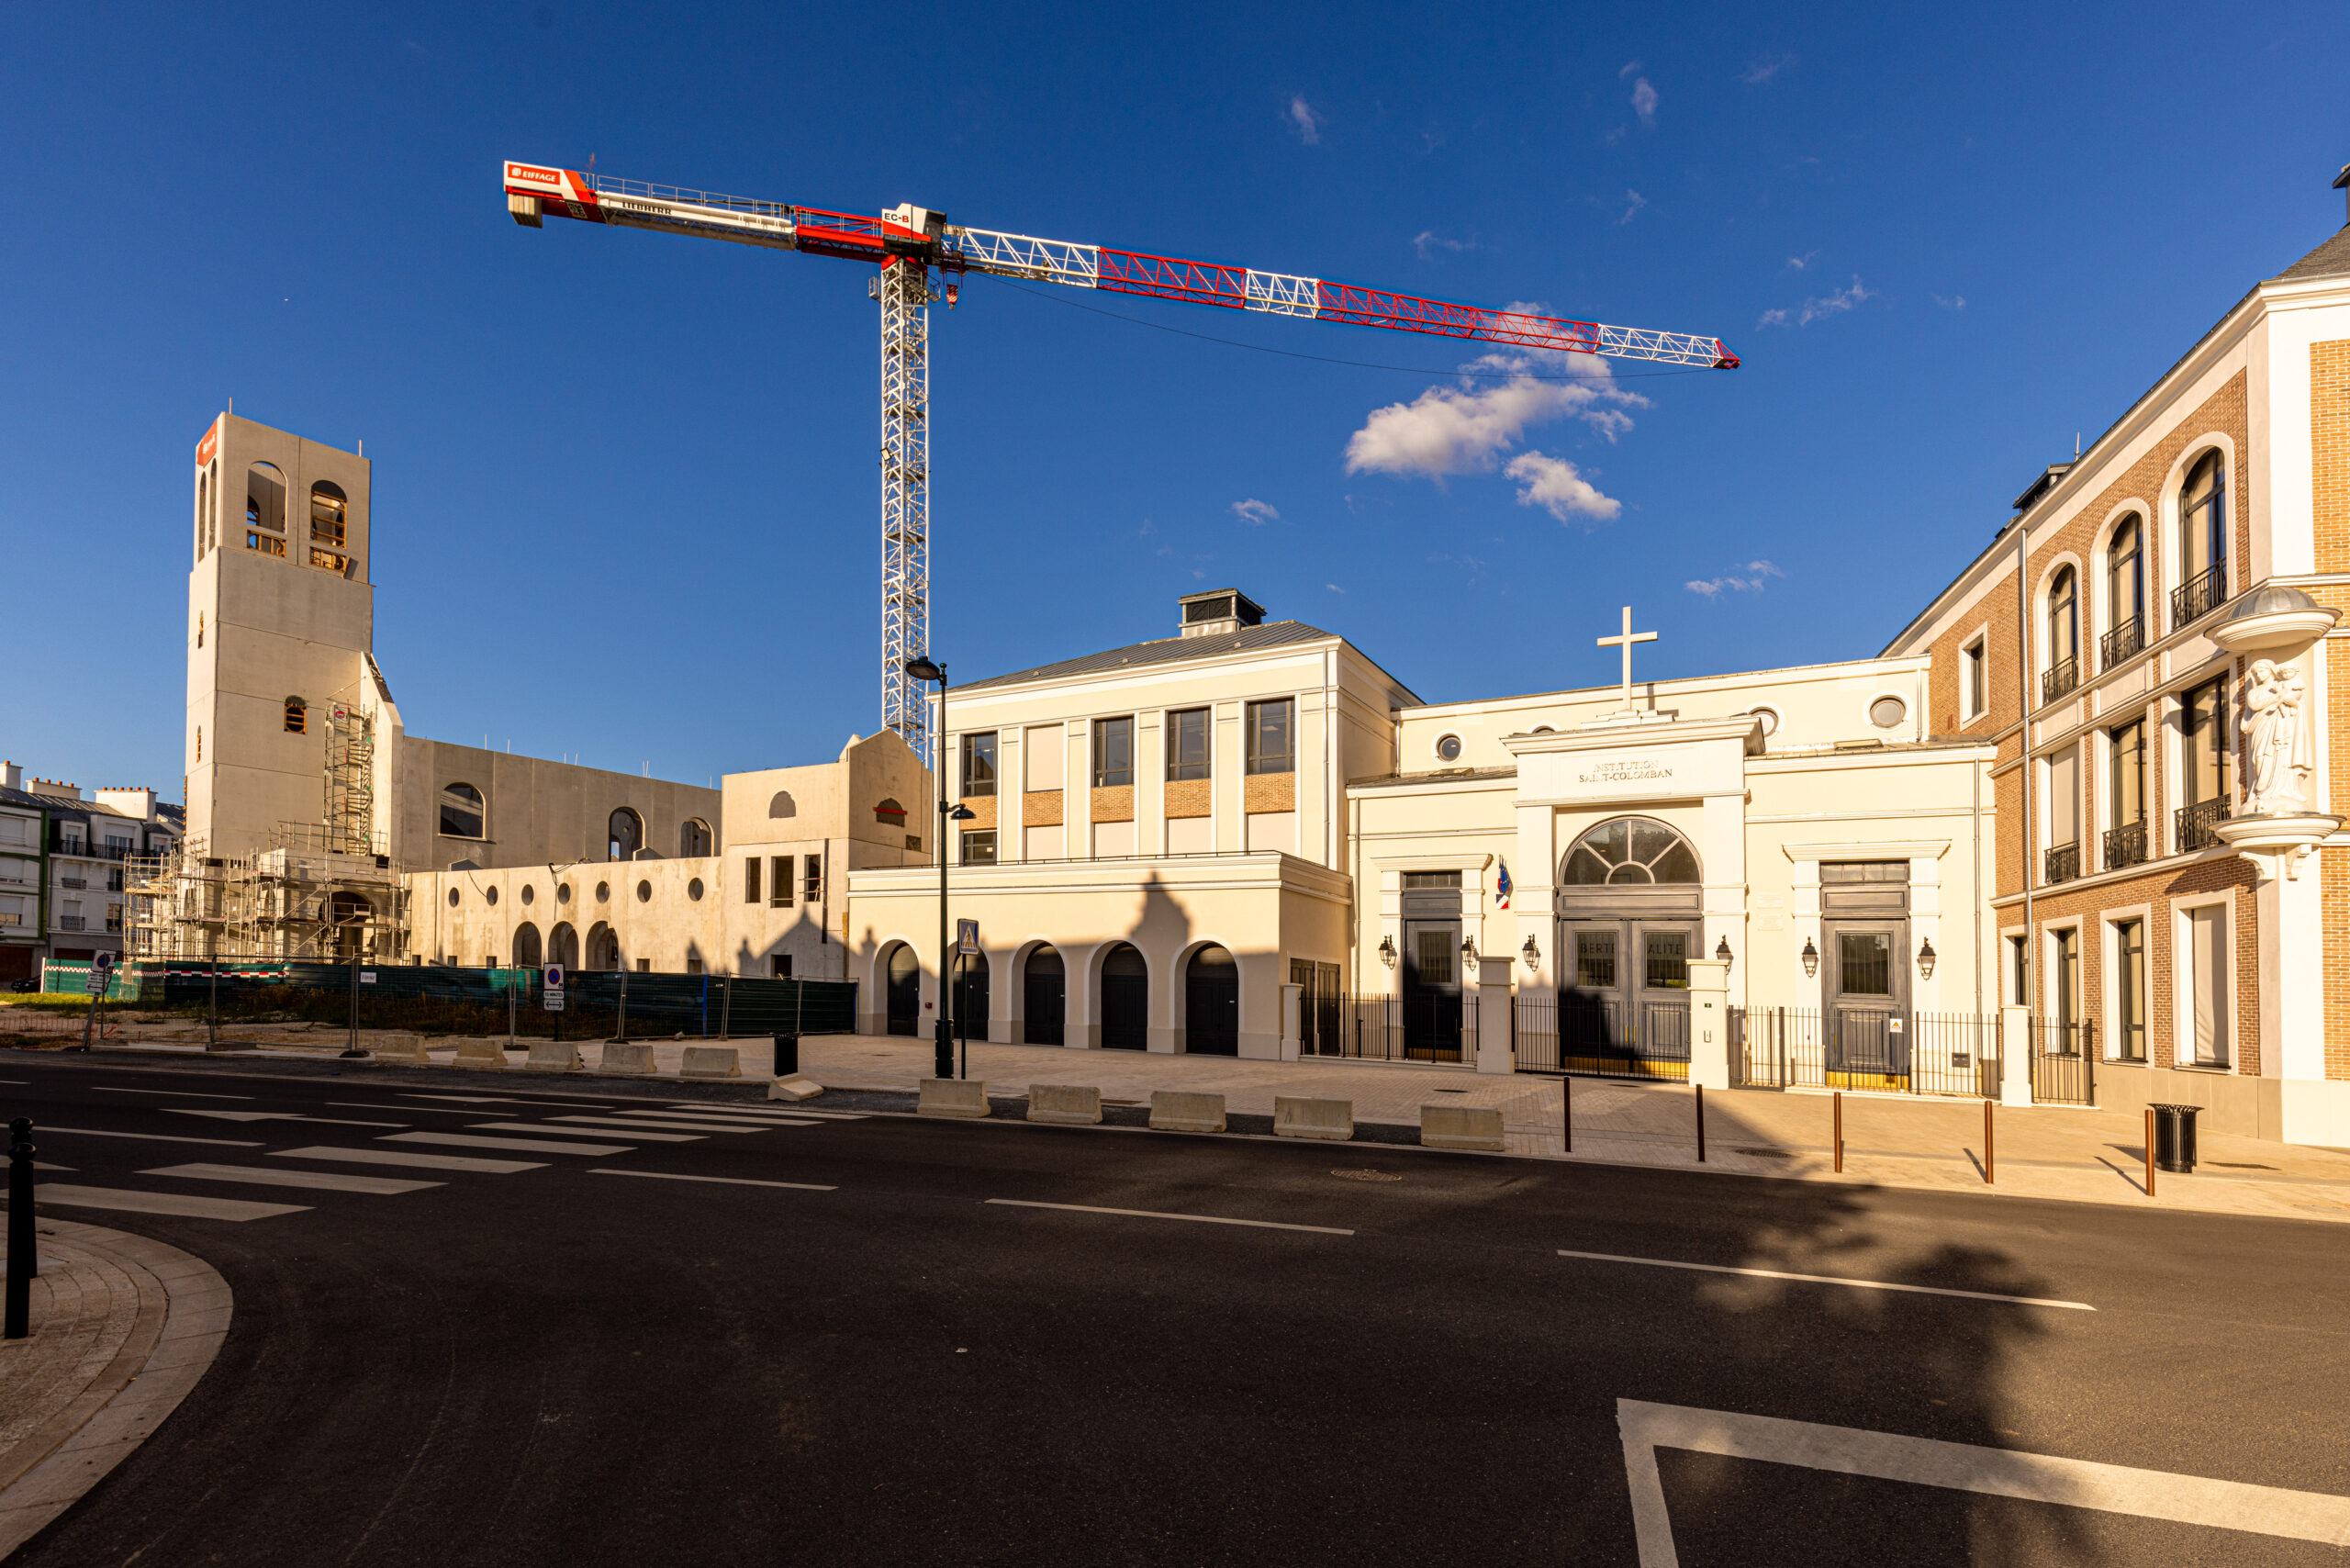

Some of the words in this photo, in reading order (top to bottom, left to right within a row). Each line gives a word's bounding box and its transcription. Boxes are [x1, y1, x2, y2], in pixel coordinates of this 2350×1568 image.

[522, 170, 556, 183] EIFFAGE
[622, 201, 672, 215] LIEBHERR
[884, 212, 910, 223] EC-B
[1593, 759, 1660, 773] INSTITUTION
